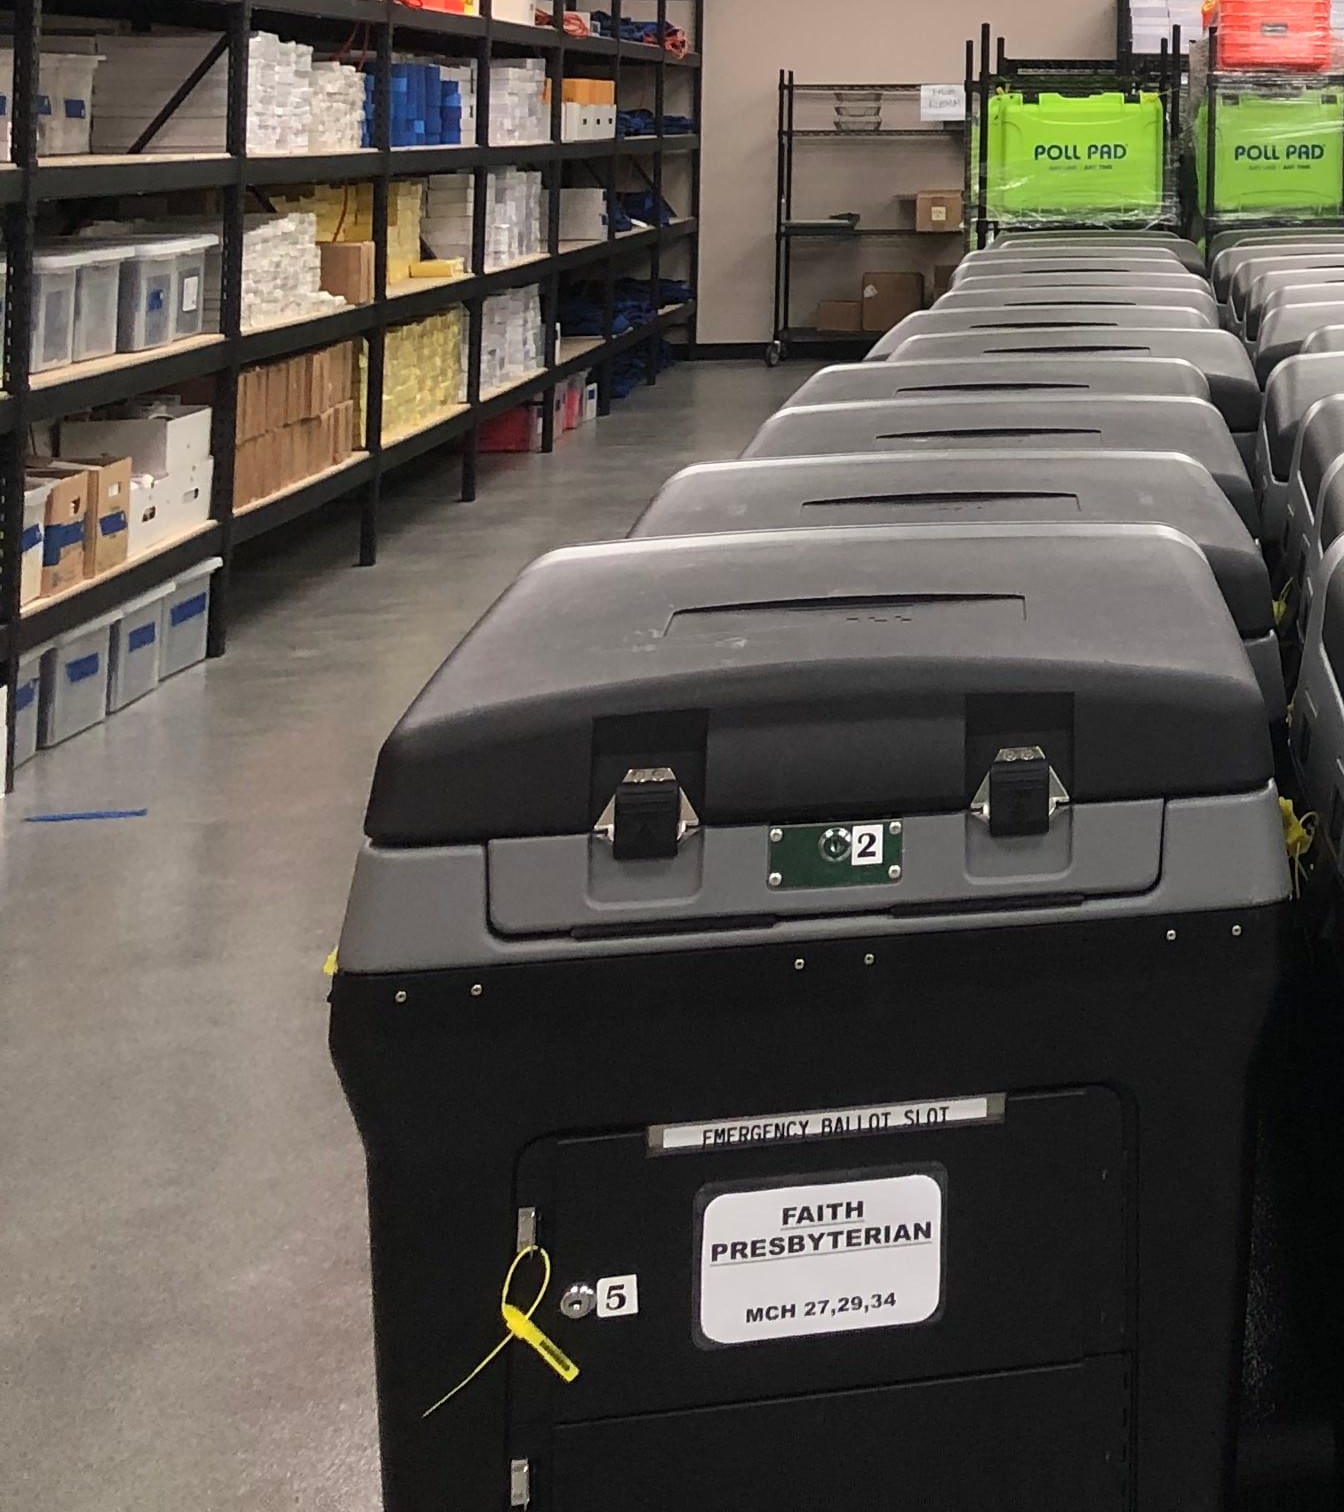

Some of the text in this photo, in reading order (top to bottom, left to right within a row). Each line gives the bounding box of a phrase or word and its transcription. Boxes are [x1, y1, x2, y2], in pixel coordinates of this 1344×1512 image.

[1034, 144, 1127, 160] POLL PAD
[1234, 144, 1324, 160] POLL PAD
[857, 832, 877, 858] 2
[702, 1106, 951, 1147] EMERGENCY BALLOT SLOT
[781, 1200, 864, 1226] FAITH
[711, 1221, 932, 1262] PRESBYTERIAN
[606, 1284, 626, 1311] 5
[746, 1292, 897, 1323] MCH 27,29,34
